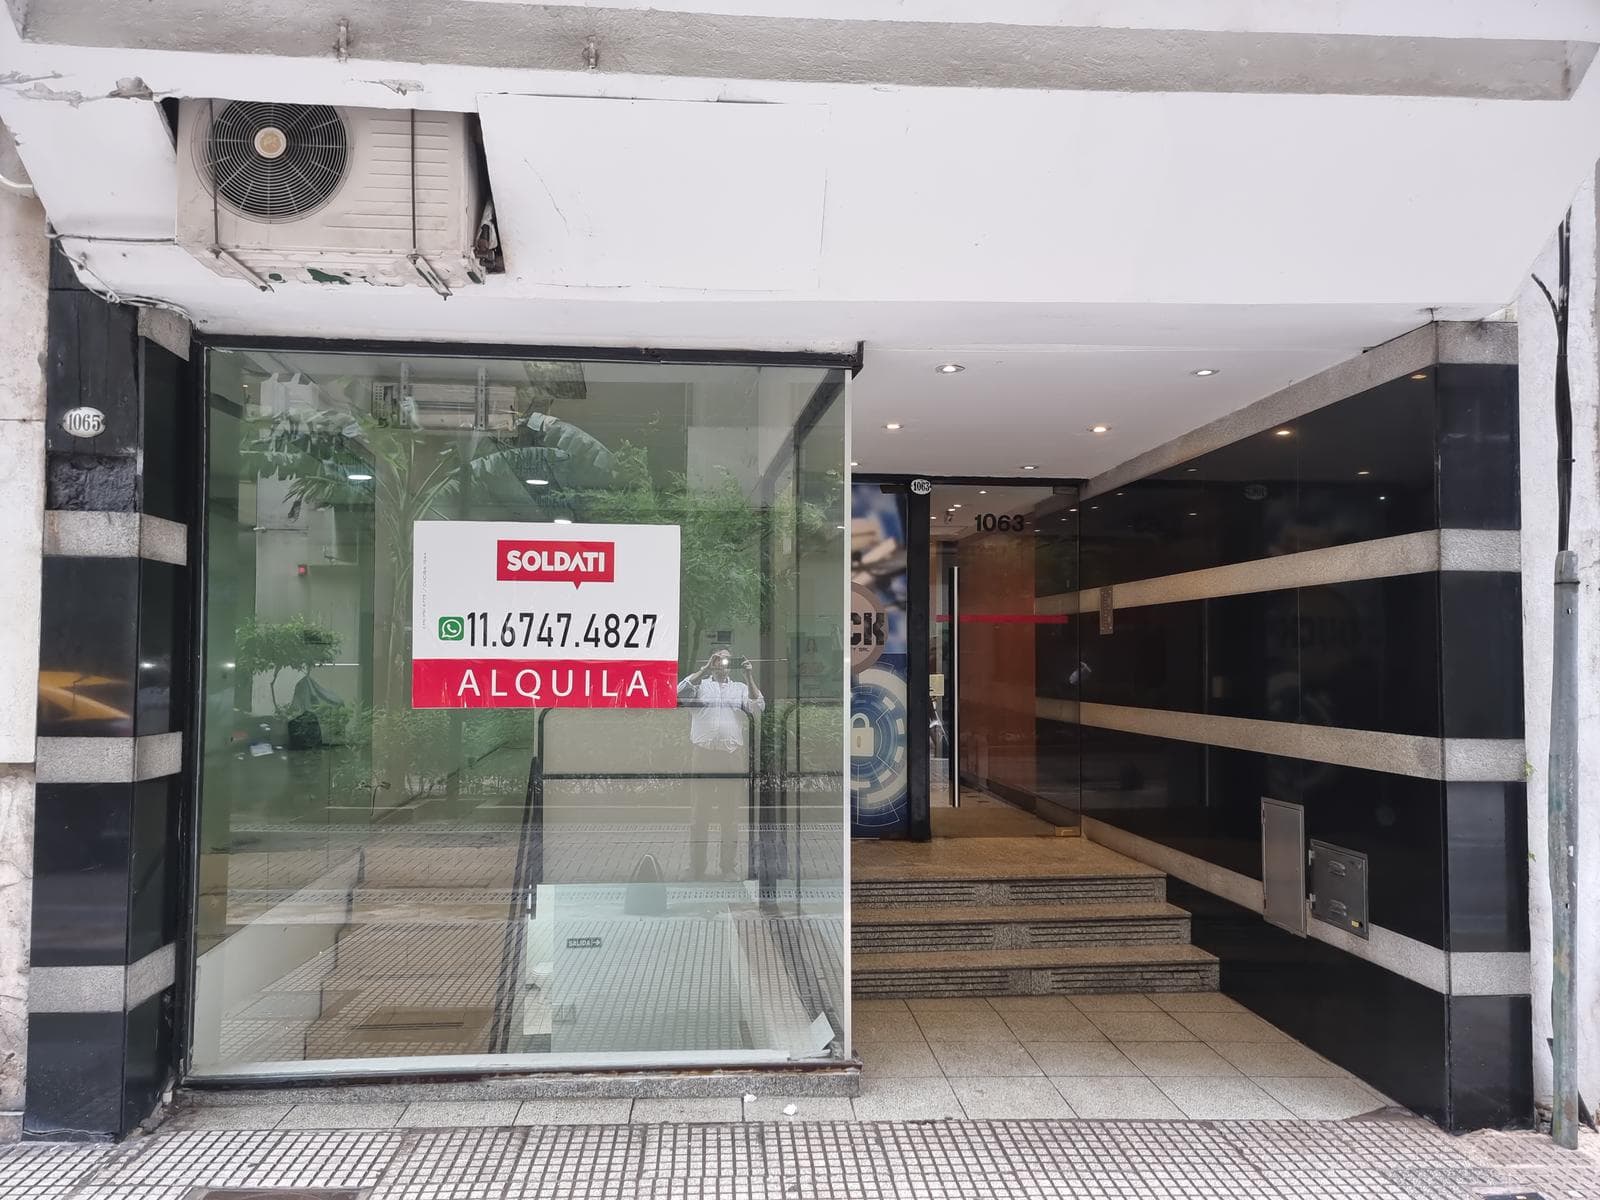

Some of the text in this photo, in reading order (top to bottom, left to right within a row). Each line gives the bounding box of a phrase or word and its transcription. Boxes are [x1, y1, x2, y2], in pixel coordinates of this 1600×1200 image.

[69, 413, 101, 431] 1065
[913, 481, 930, 492] 1063
[974, 513, 1025, 532] 1063
[506, 550, 605, 572] SOLDATI
[467, 612, 658, 648] 11.6747.4827
[457, 669, 650, 700] ALQUILA
